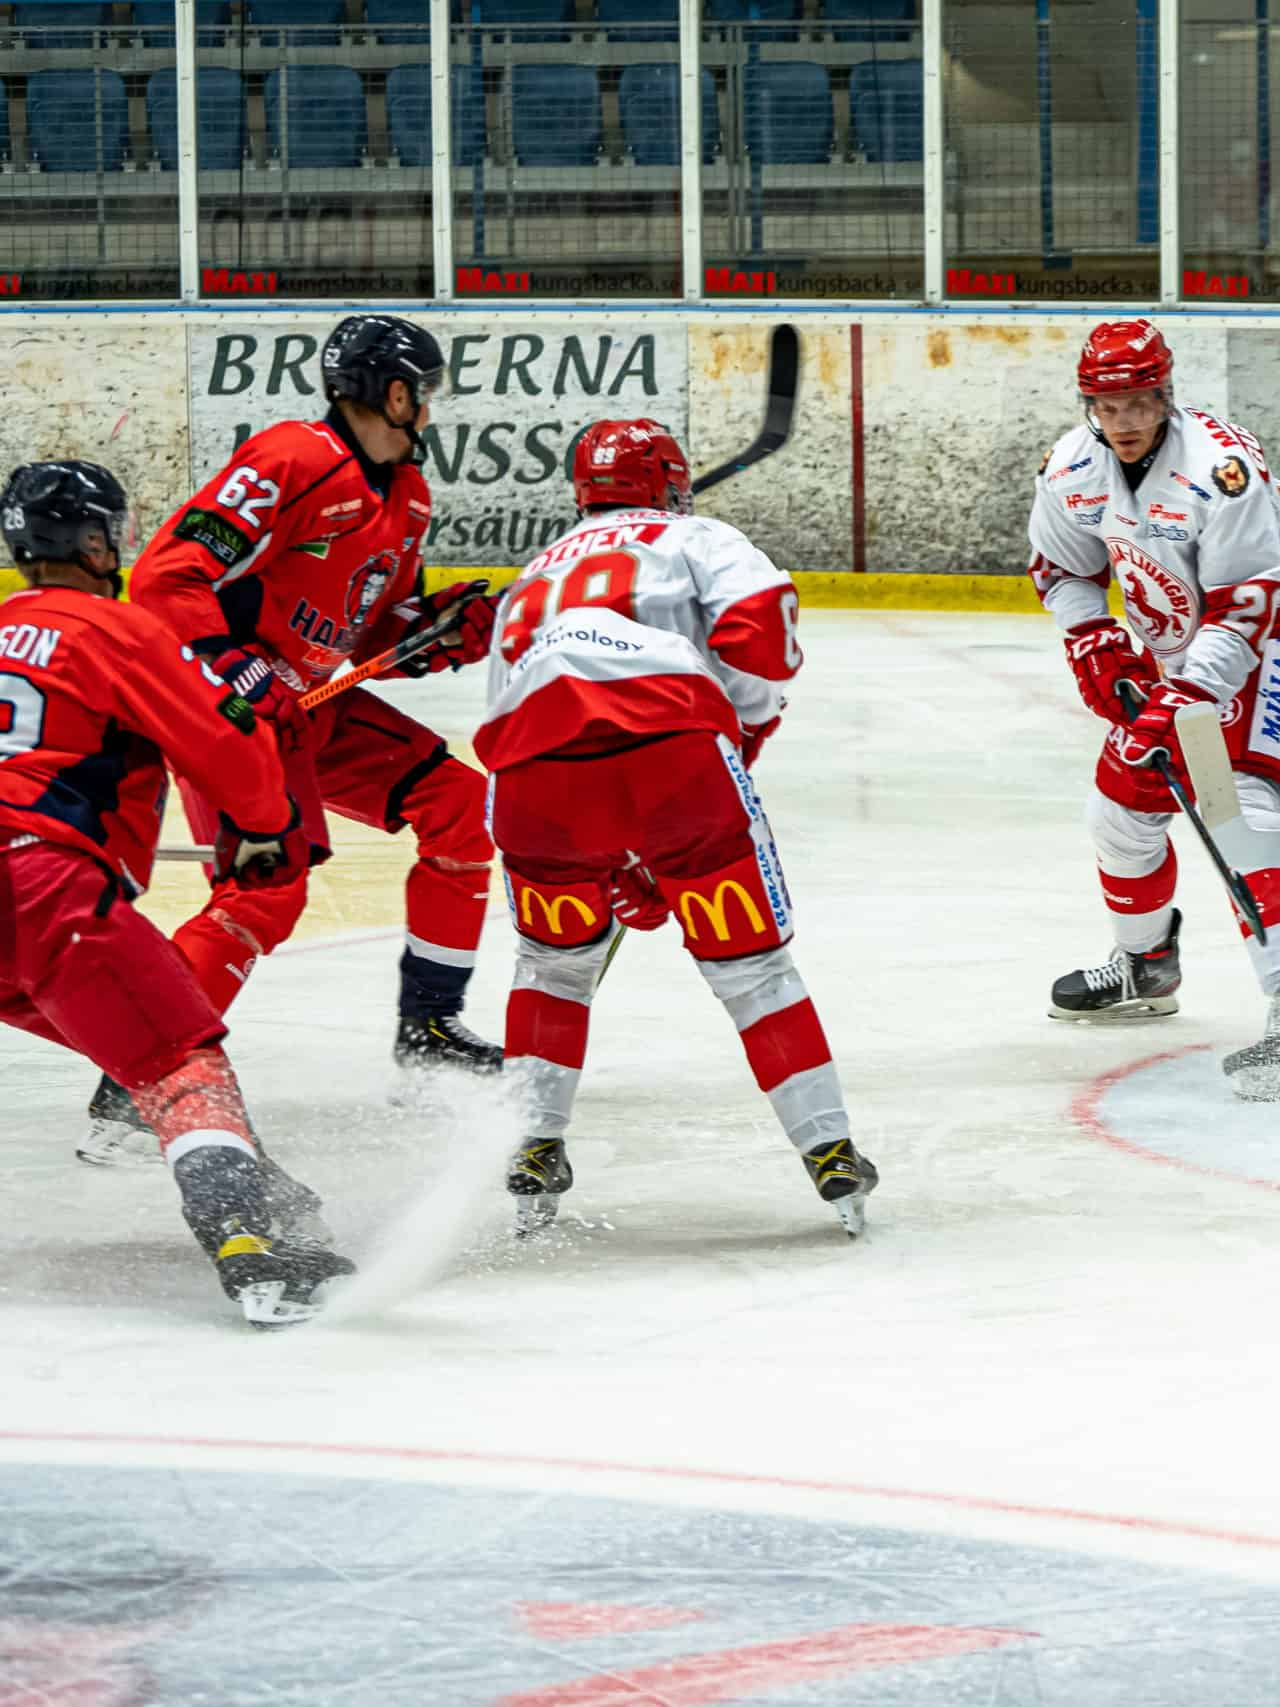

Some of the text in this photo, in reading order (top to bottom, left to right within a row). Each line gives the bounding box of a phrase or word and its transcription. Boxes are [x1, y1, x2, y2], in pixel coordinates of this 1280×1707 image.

[207, 333, 659, 396] BRERNA
[3, 506, 25, 531] 28
[217, 466, 280, 528] 62
